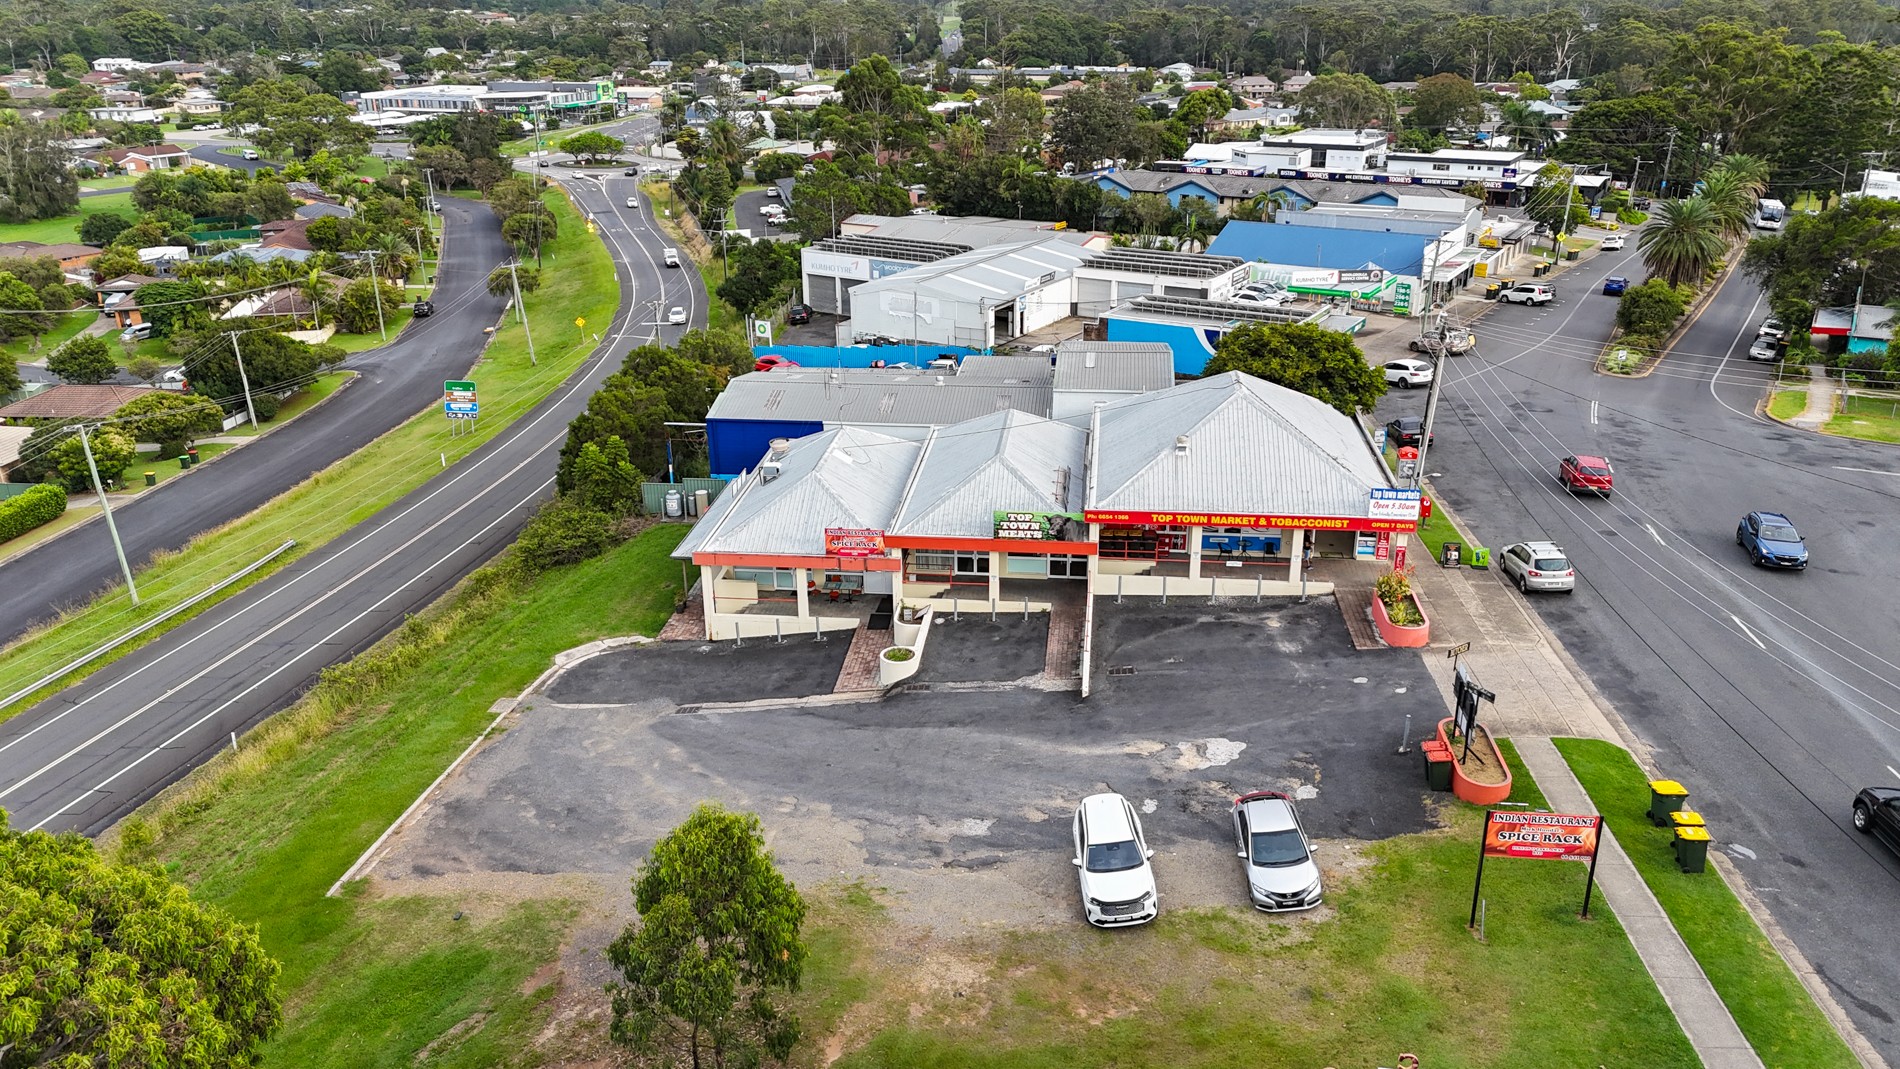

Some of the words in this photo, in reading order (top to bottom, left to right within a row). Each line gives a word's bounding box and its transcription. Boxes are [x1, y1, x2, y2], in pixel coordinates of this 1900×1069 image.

[811, 262, 835, 272] KUMHO
[835, 265, 853, 274] TYRE
[1372, 489, 1382, 499] top
[1382, 489, 1397, 498] town
[1397, 490, 1421, 500] markets
[1373, 501, 1389, 510] Open
[1391, 502, 1416, 510] 5.30am
[1008, 513, 1033, 522] TOP
[1151, 514, 1174, 523] TOP
[1176, 515, 1208, 524] TOWN
[1211, 516, 1256, 525] MARKET
[1258, 517, 1268, 526] &
[1270, 517, 1350, 528] TOBACCONIST
[1000, 521, 1041, 530] TOWN
[998, 529, 1042, 539] MEATS
[1493, 813, 1529, 823] INDIAN
[1530, 814, 1595, 826] RESTAURANT
[1498, 831, 1540, 842] SPICE
[1542, 834, 1584, 844] RACK
